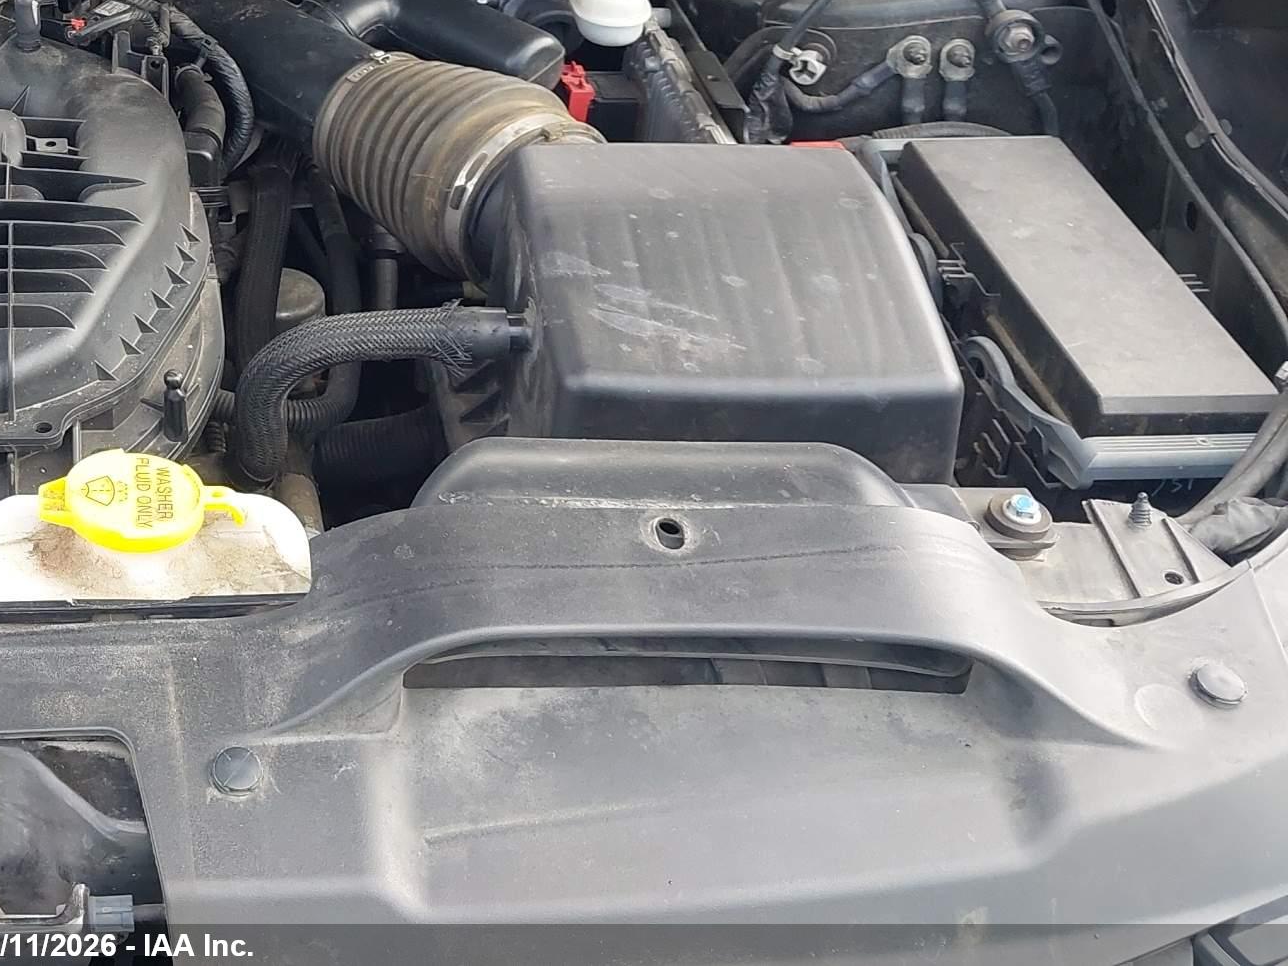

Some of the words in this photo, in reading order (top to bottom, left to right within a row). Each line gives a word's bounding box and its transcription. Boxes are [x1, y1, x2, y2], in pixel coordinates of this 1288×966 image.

[135, 457, 151, 492] FLUID
[156, 467, 174, 520] WASHER
[136, 495, 153, 528] ONLY
